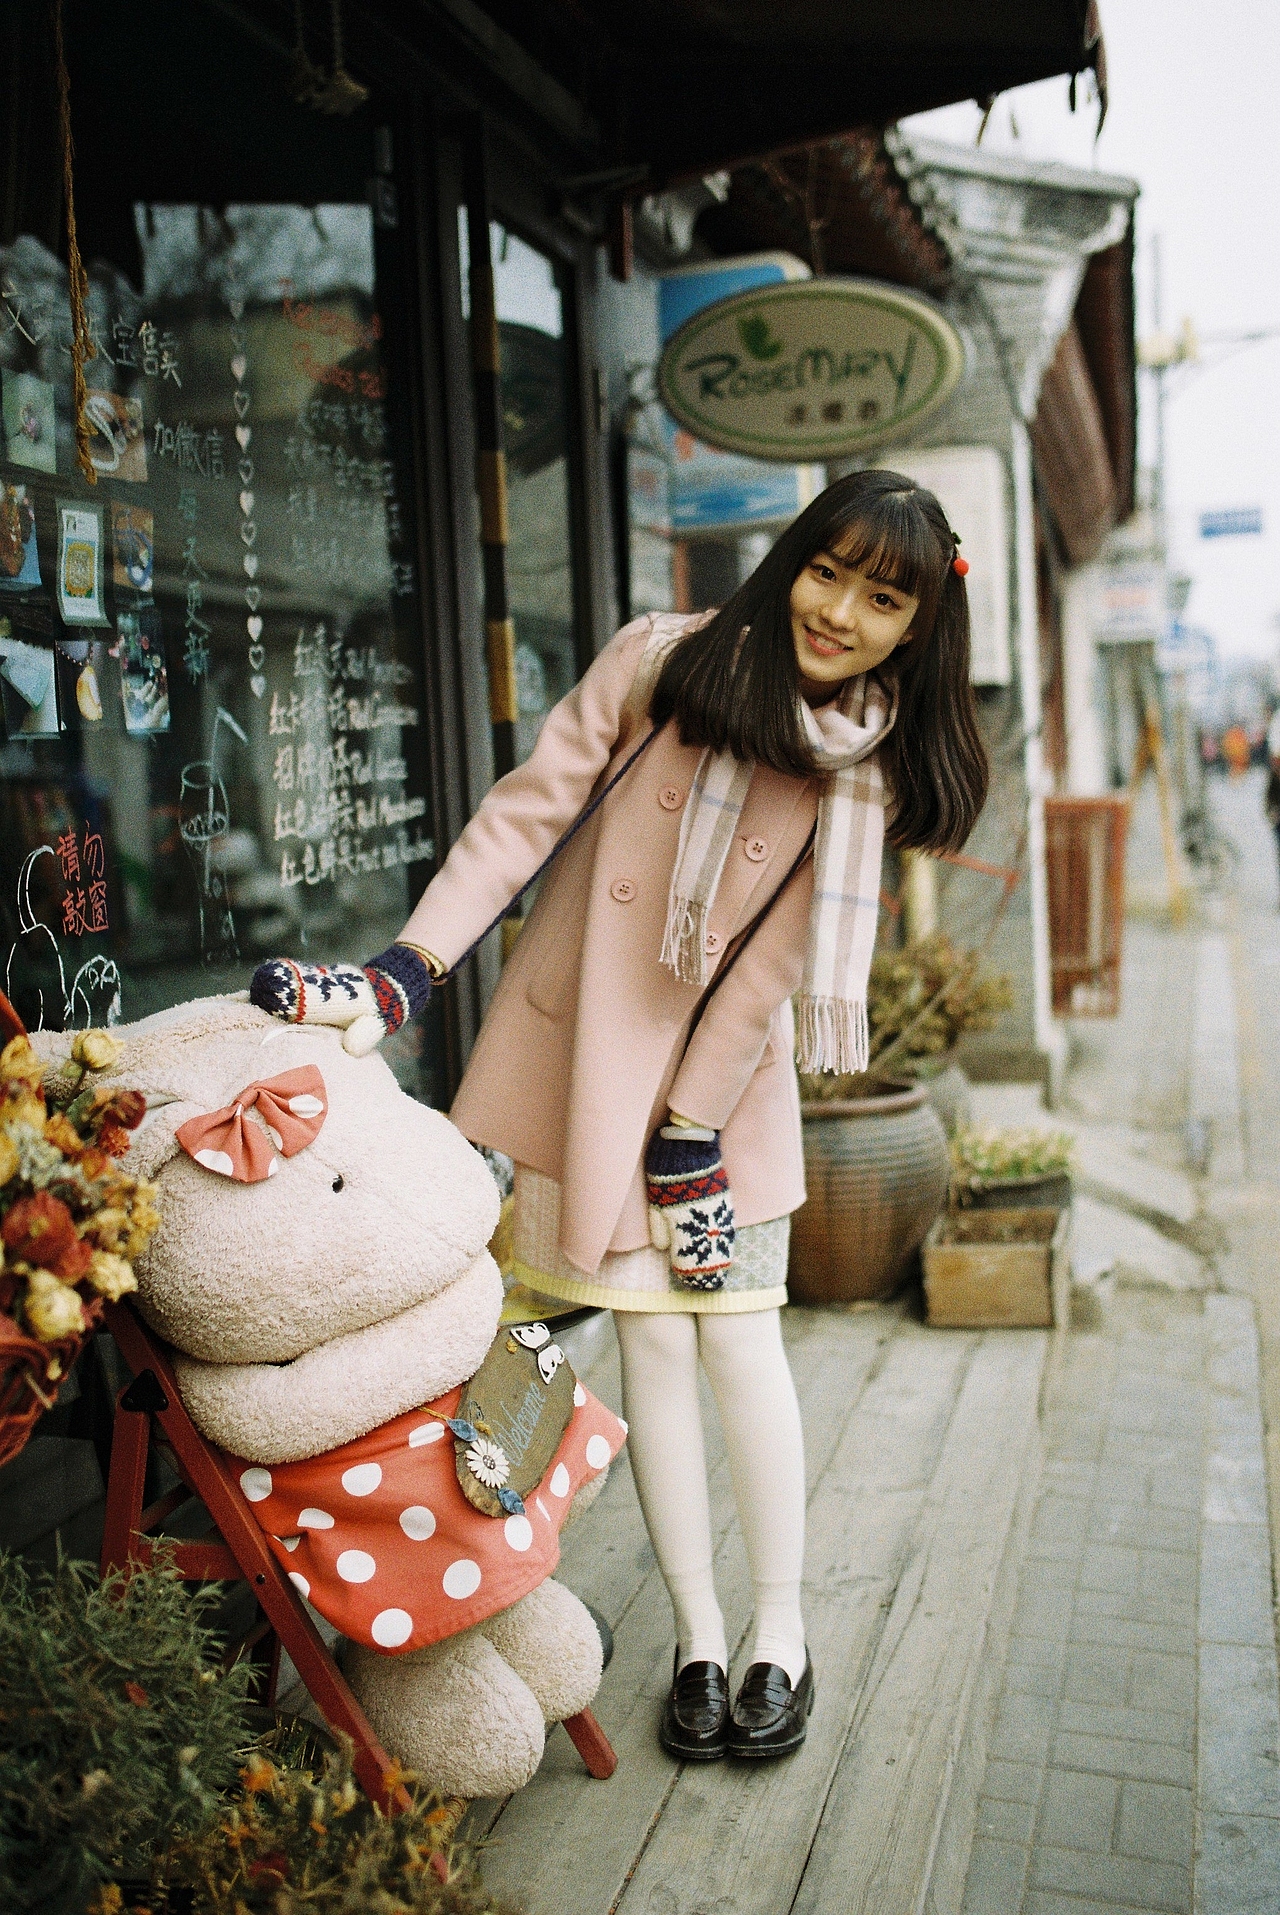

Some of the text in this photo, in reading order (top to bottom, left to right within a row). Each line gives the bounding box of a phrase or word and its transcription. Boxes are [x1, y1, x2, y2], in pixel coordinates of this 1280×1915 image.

[153, 421, 224, 480] 加微信
[56, 820, 104, 881] 请勿
[490, 1382, 547, 1467] Welcome
